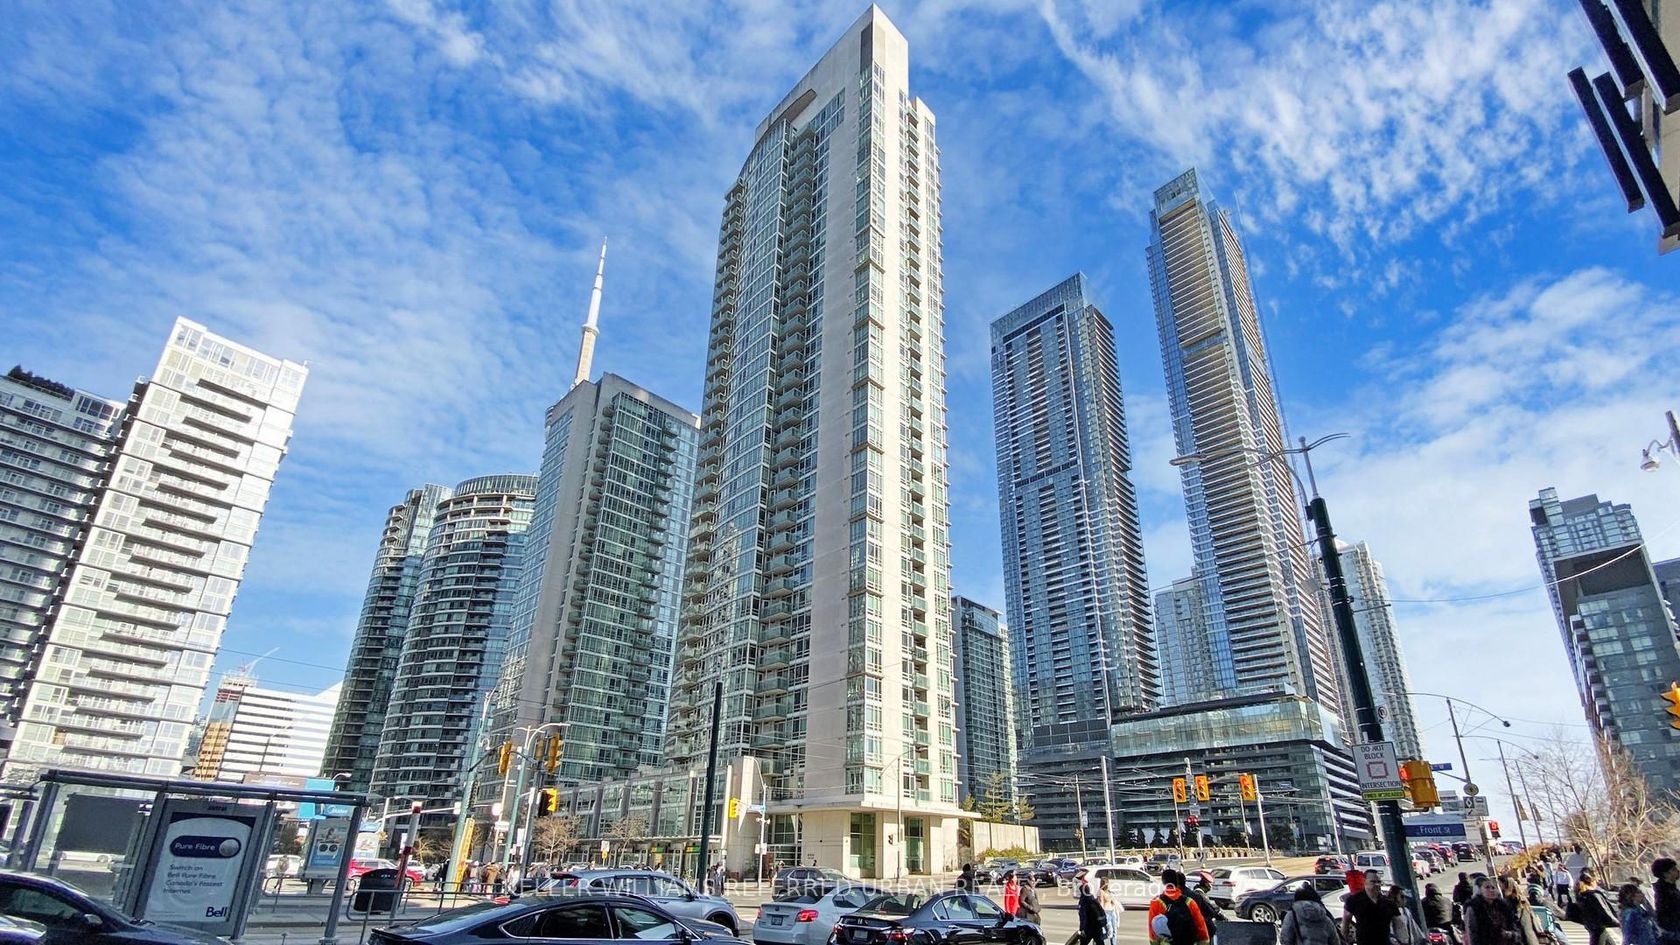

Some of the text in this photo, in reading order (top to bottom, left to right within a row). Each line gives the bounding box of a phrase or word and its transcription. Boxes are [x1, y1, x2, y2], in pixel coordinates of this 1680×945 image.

[1360, 781, 1401, 789] INTERSECTION
[1420, 826, 1442, 834] Front
[195, 843, 216, 851] Fibre
[205, 906, 228, 918] Bell
